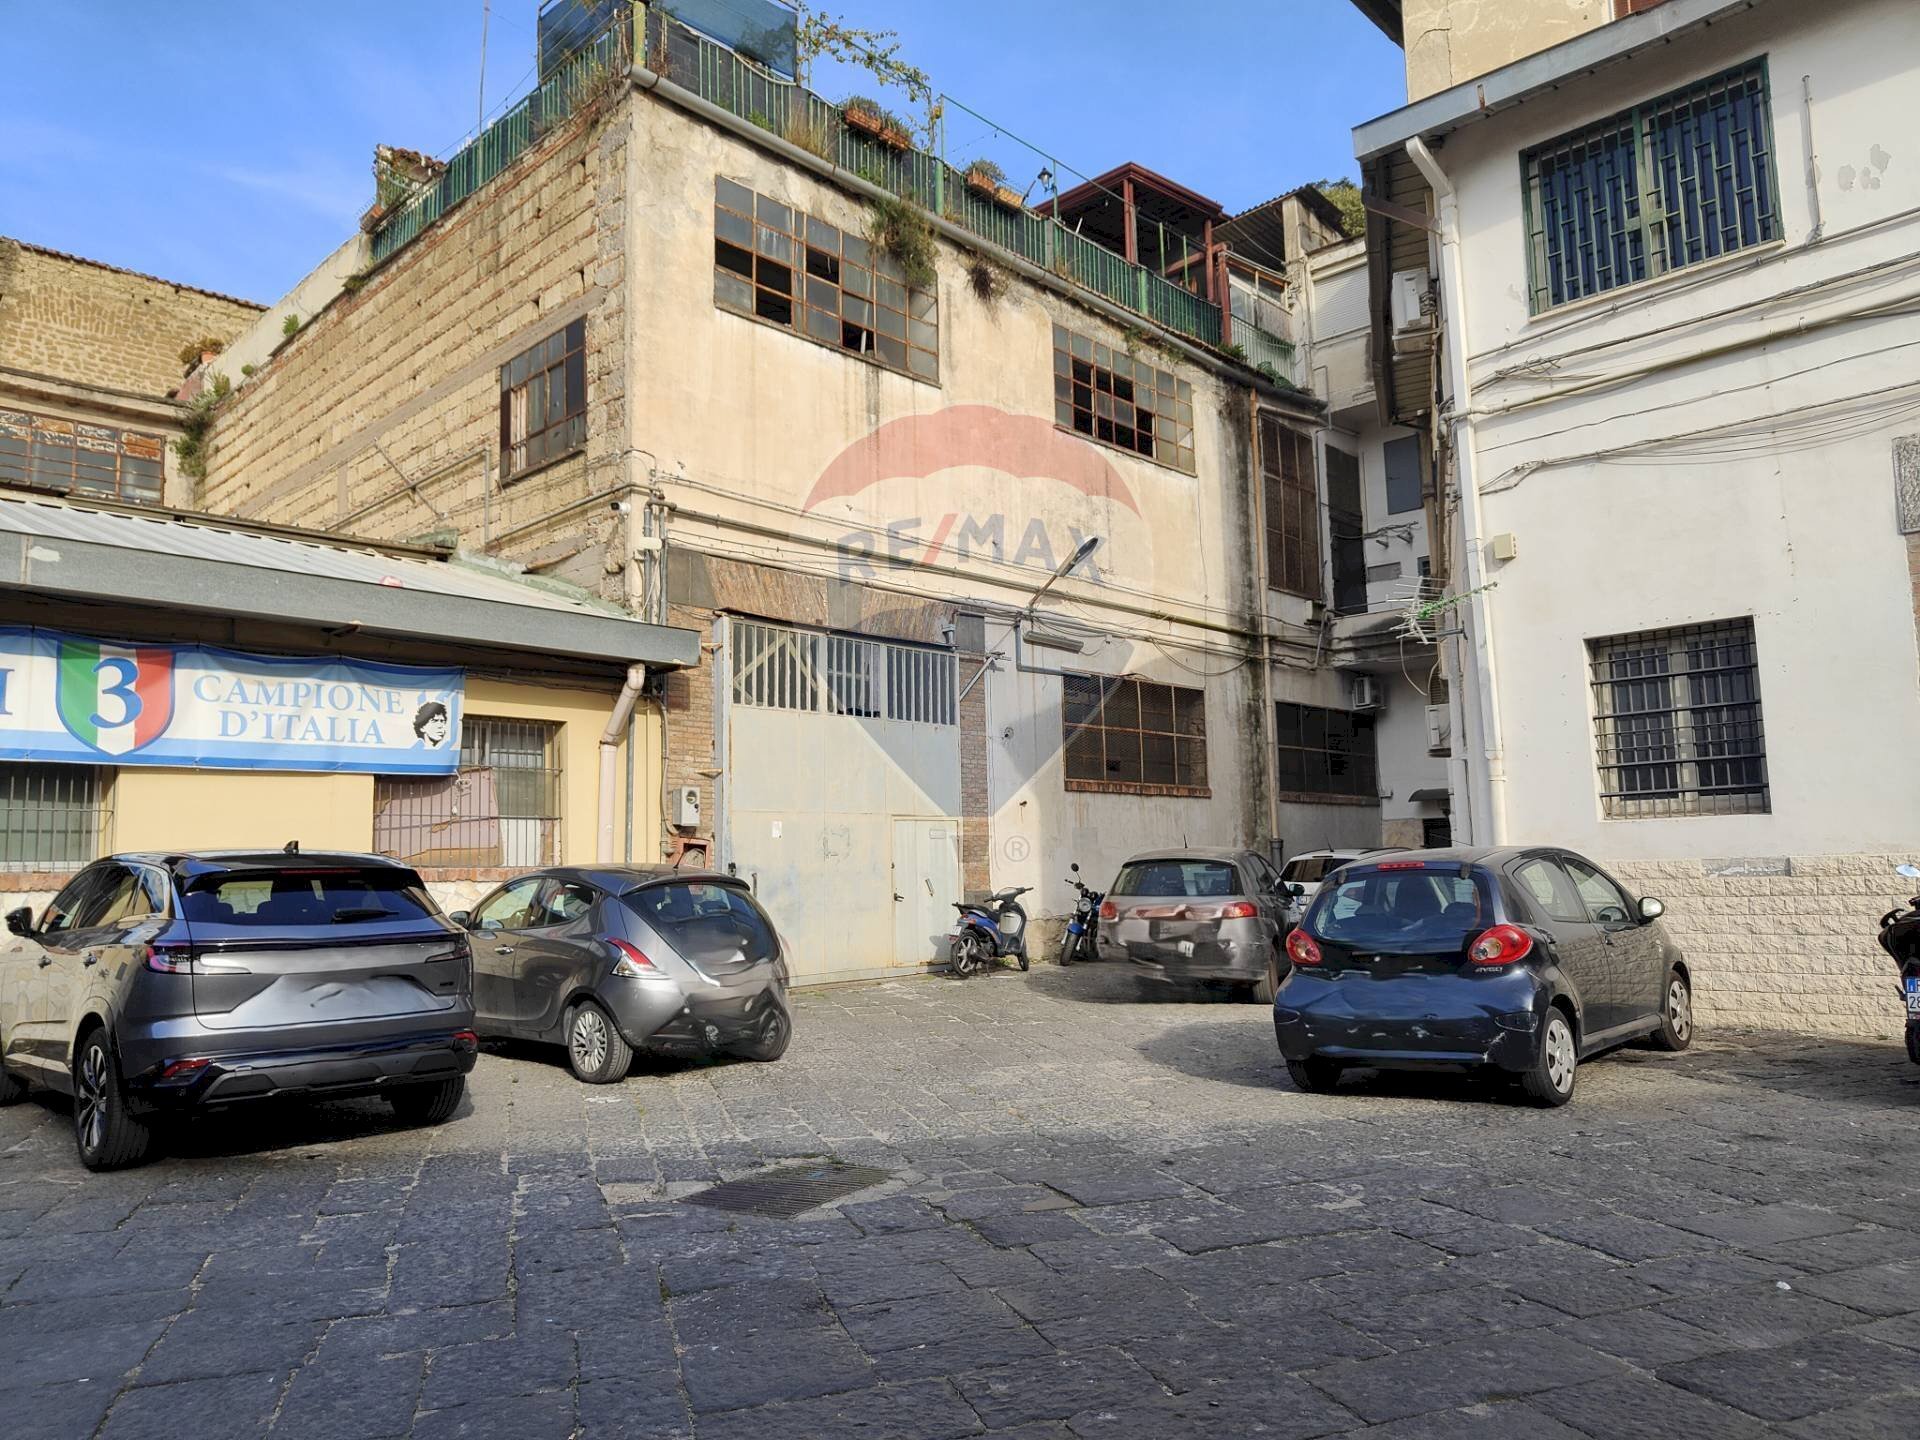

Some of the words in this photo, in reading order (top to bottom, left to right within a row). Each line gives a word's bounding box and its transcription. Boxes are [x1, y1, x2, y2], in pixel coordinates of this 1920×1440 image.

[89, 656, 144, 728] 3
[192, 675, 405, 714] CAMPIONE
[217, 710, 385, 744] D'ITALIA
